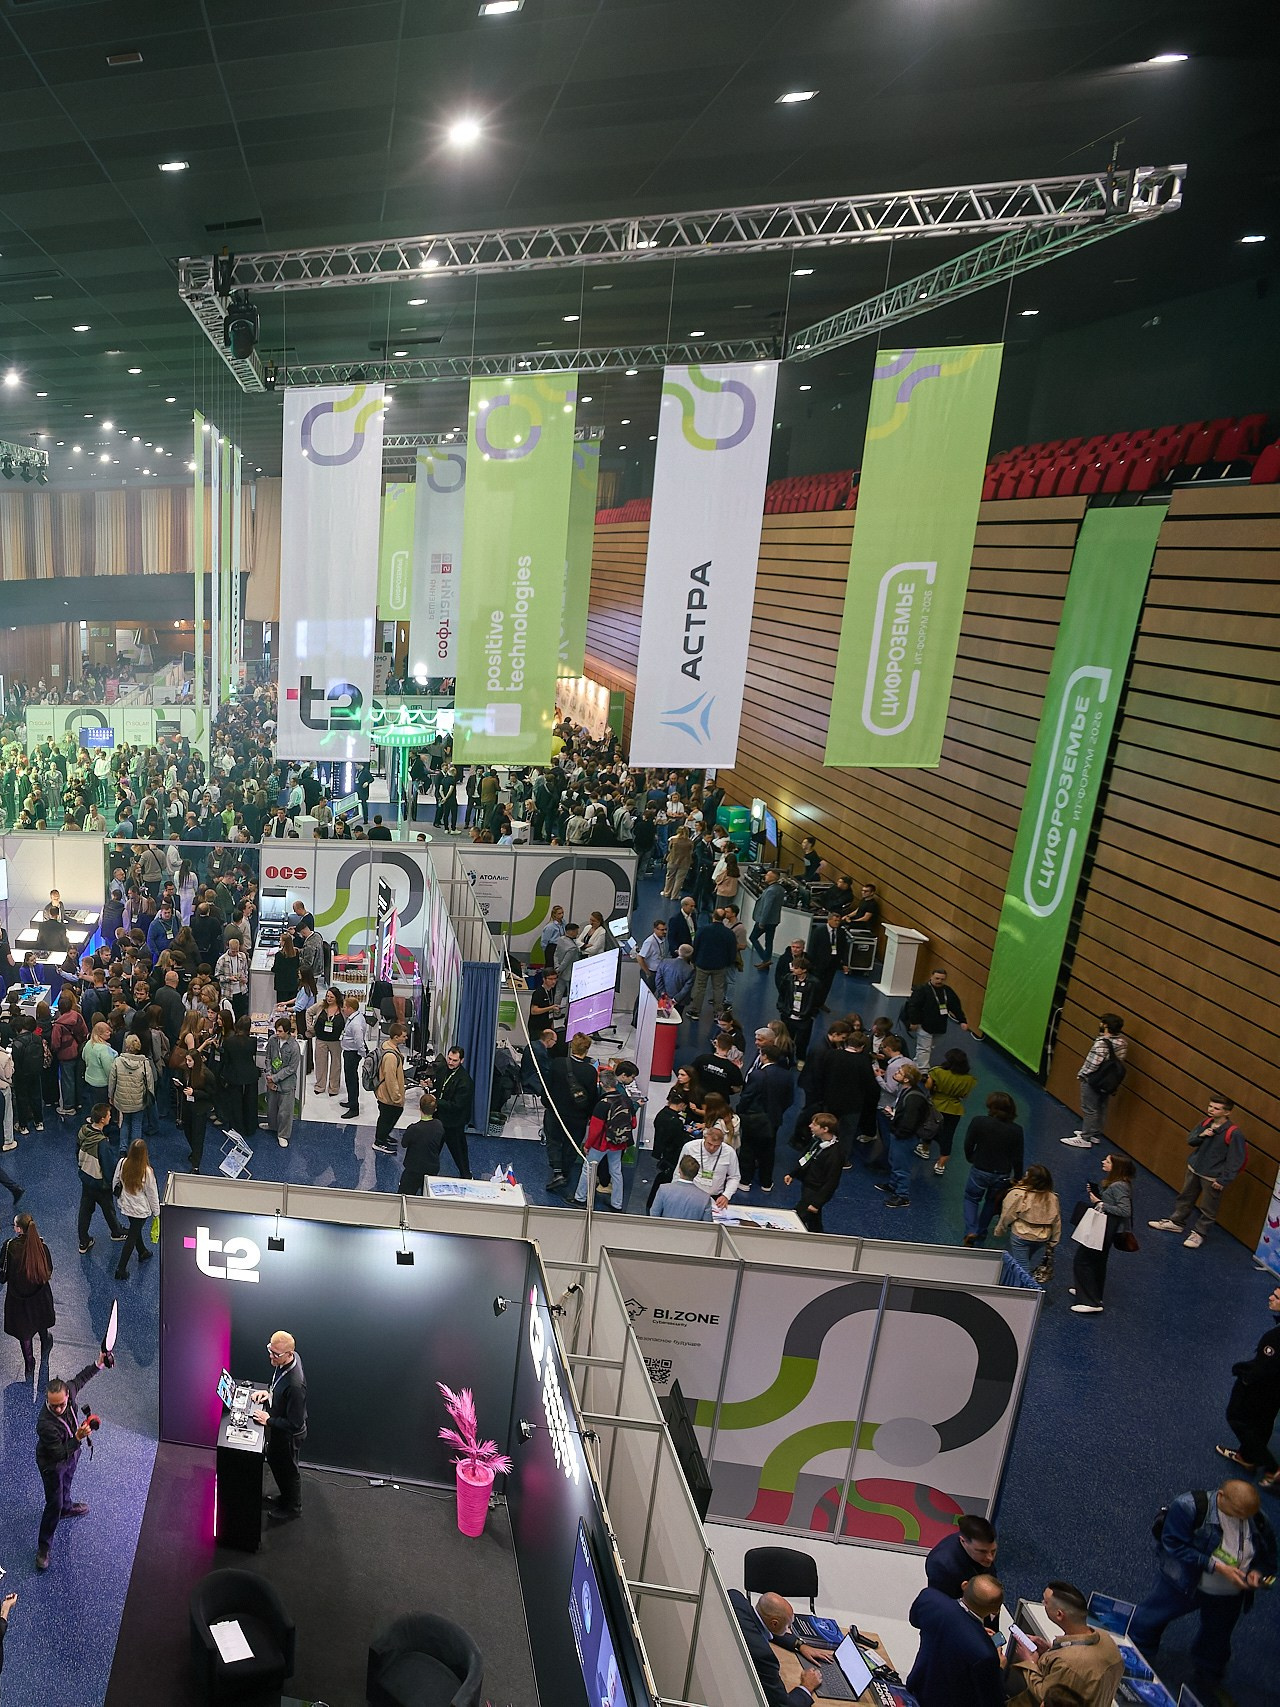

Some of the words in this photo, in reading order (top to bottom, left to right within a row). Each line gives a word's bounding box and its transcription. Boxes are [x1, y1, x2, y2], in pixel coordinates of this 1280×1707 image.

[485, 610, 504, 691] positive
[505, 555, 535, 692] technologies
[681, 560, 712, 681] АСТРА
[880, 582, 916, 716] ЦИФРОЗЕМЬЕ
[914, 615, 929, 665] ИТ-ФОРУМ
[922, 590, 933, 612] 2026
[287, 675, 364, 730] t2
[1037, 695, 1090, 889] ЦИФРОЗЕМЬЕ
[1072, 749, 1095, 821] ИТ-ФОРУМ
[1091, 711, 1103, 745] 2026
[184, 1226, 260, 1283] t2
[653, 1308, 720, 1325] BI.ZONE
